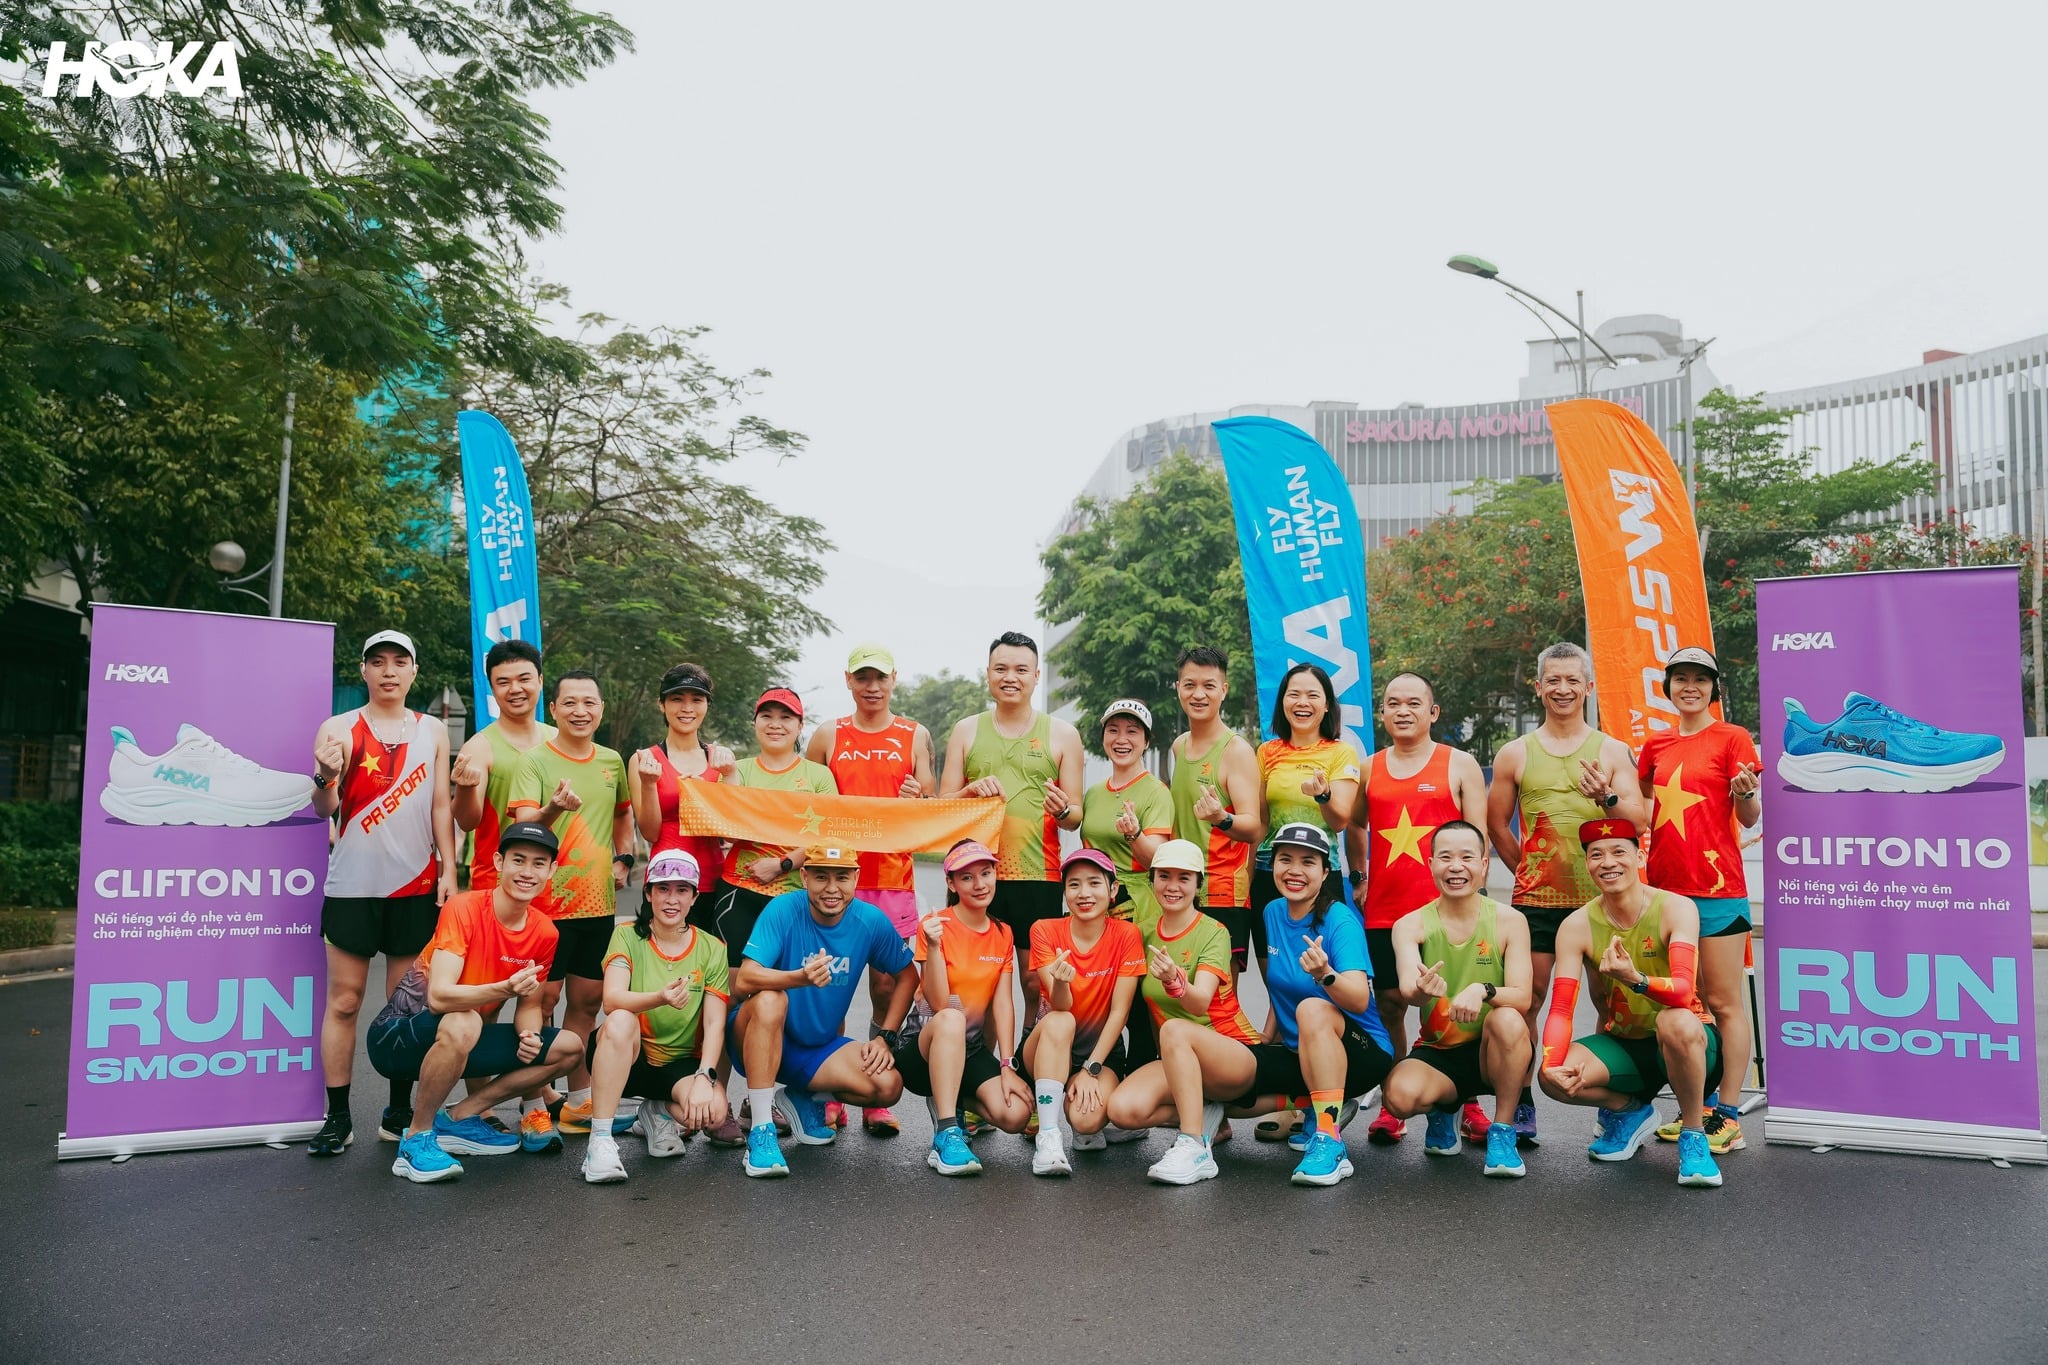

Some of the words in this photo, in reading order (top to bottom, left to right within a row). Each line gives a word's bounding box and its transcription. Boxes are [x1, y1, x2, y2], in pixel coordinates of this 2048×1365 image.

[1347, 418, 1455, 443] SAKURA
[481, 503, 498, 550] FLY
[493, 465, 513, 581] HUMAN
[509, 500, 524, 548] FLY
[1267, 506, 1295, 554] FLY
[1284, 465, 1324, 583] HUMAN
[1314, 498, 1343, 547] FLY
[1771, 631, 1837, 651] HOKA
[104, 663, 170, 684] HOKA
[837, 749, 903, 762] ANTA
[1822, 729, 1886, 758] HOKA
[153, 764, 211, 792] HOKA
[360, 806, 386, 836] PR
[382, 762, 428, 815] SPORT
[827, 829, 861, 840] running
[863, 830, 883, 839] club
[1776, 836, 1948, 867] CLIFTON
[1956, 838, 2012, 869] 10
[94, 868, 261, 898] CLIFTON
[269, 868, 315, 896] 10
[1778, 878, 1800, 891] Nổi
[1804, 879, 1835, 895] tiếng
[1839, 880, 1858, 892] với
[1863, 880, 1879, 895] độ
[1883, 880, 1907, 896] nhẹ
[1911, 882, 1928, 894] và
[1932, 883, 1952, 895] êm
[1778, 892, 1800, 905] cho
[1804, 893, 1825, 905] trải
[1829, 894, 1876, 909] nghiệm
[1880, 895, 1911, 911] chạy
[1915, 899, 1949, 912] mượt
[1953, 898, 1975, 910] mà
[1979, 897, 2011, 911] nhất
[93, 911, 118, 925] Nổi
[121, 911, 153, 927] tiếng
[157, 911, 177, 923] với
[180, 910, 197, 925] độ
[201, 910, 224, 925] nhẹ
[226, 911, 241, 922] và
[245, 911, 263, 922] êm
[93, 926, 116, 939] cho
[120, 926, 143, 938] trải
[146, 925, 193, 941] nghiệm
[196, 924, 226, 940] chạy
[229, 925, 260, 938] mượt
[263, 924, 282, 935] mà
[285, 922, 312, 935] nhất
[1778, 946, 2019, 1025] RUN
[86, 975, 314, 1049] RUN
[1780, 1020, 2021, 1062] SMOOTH
[85, 1046, 313, 1084] SMOOTH
